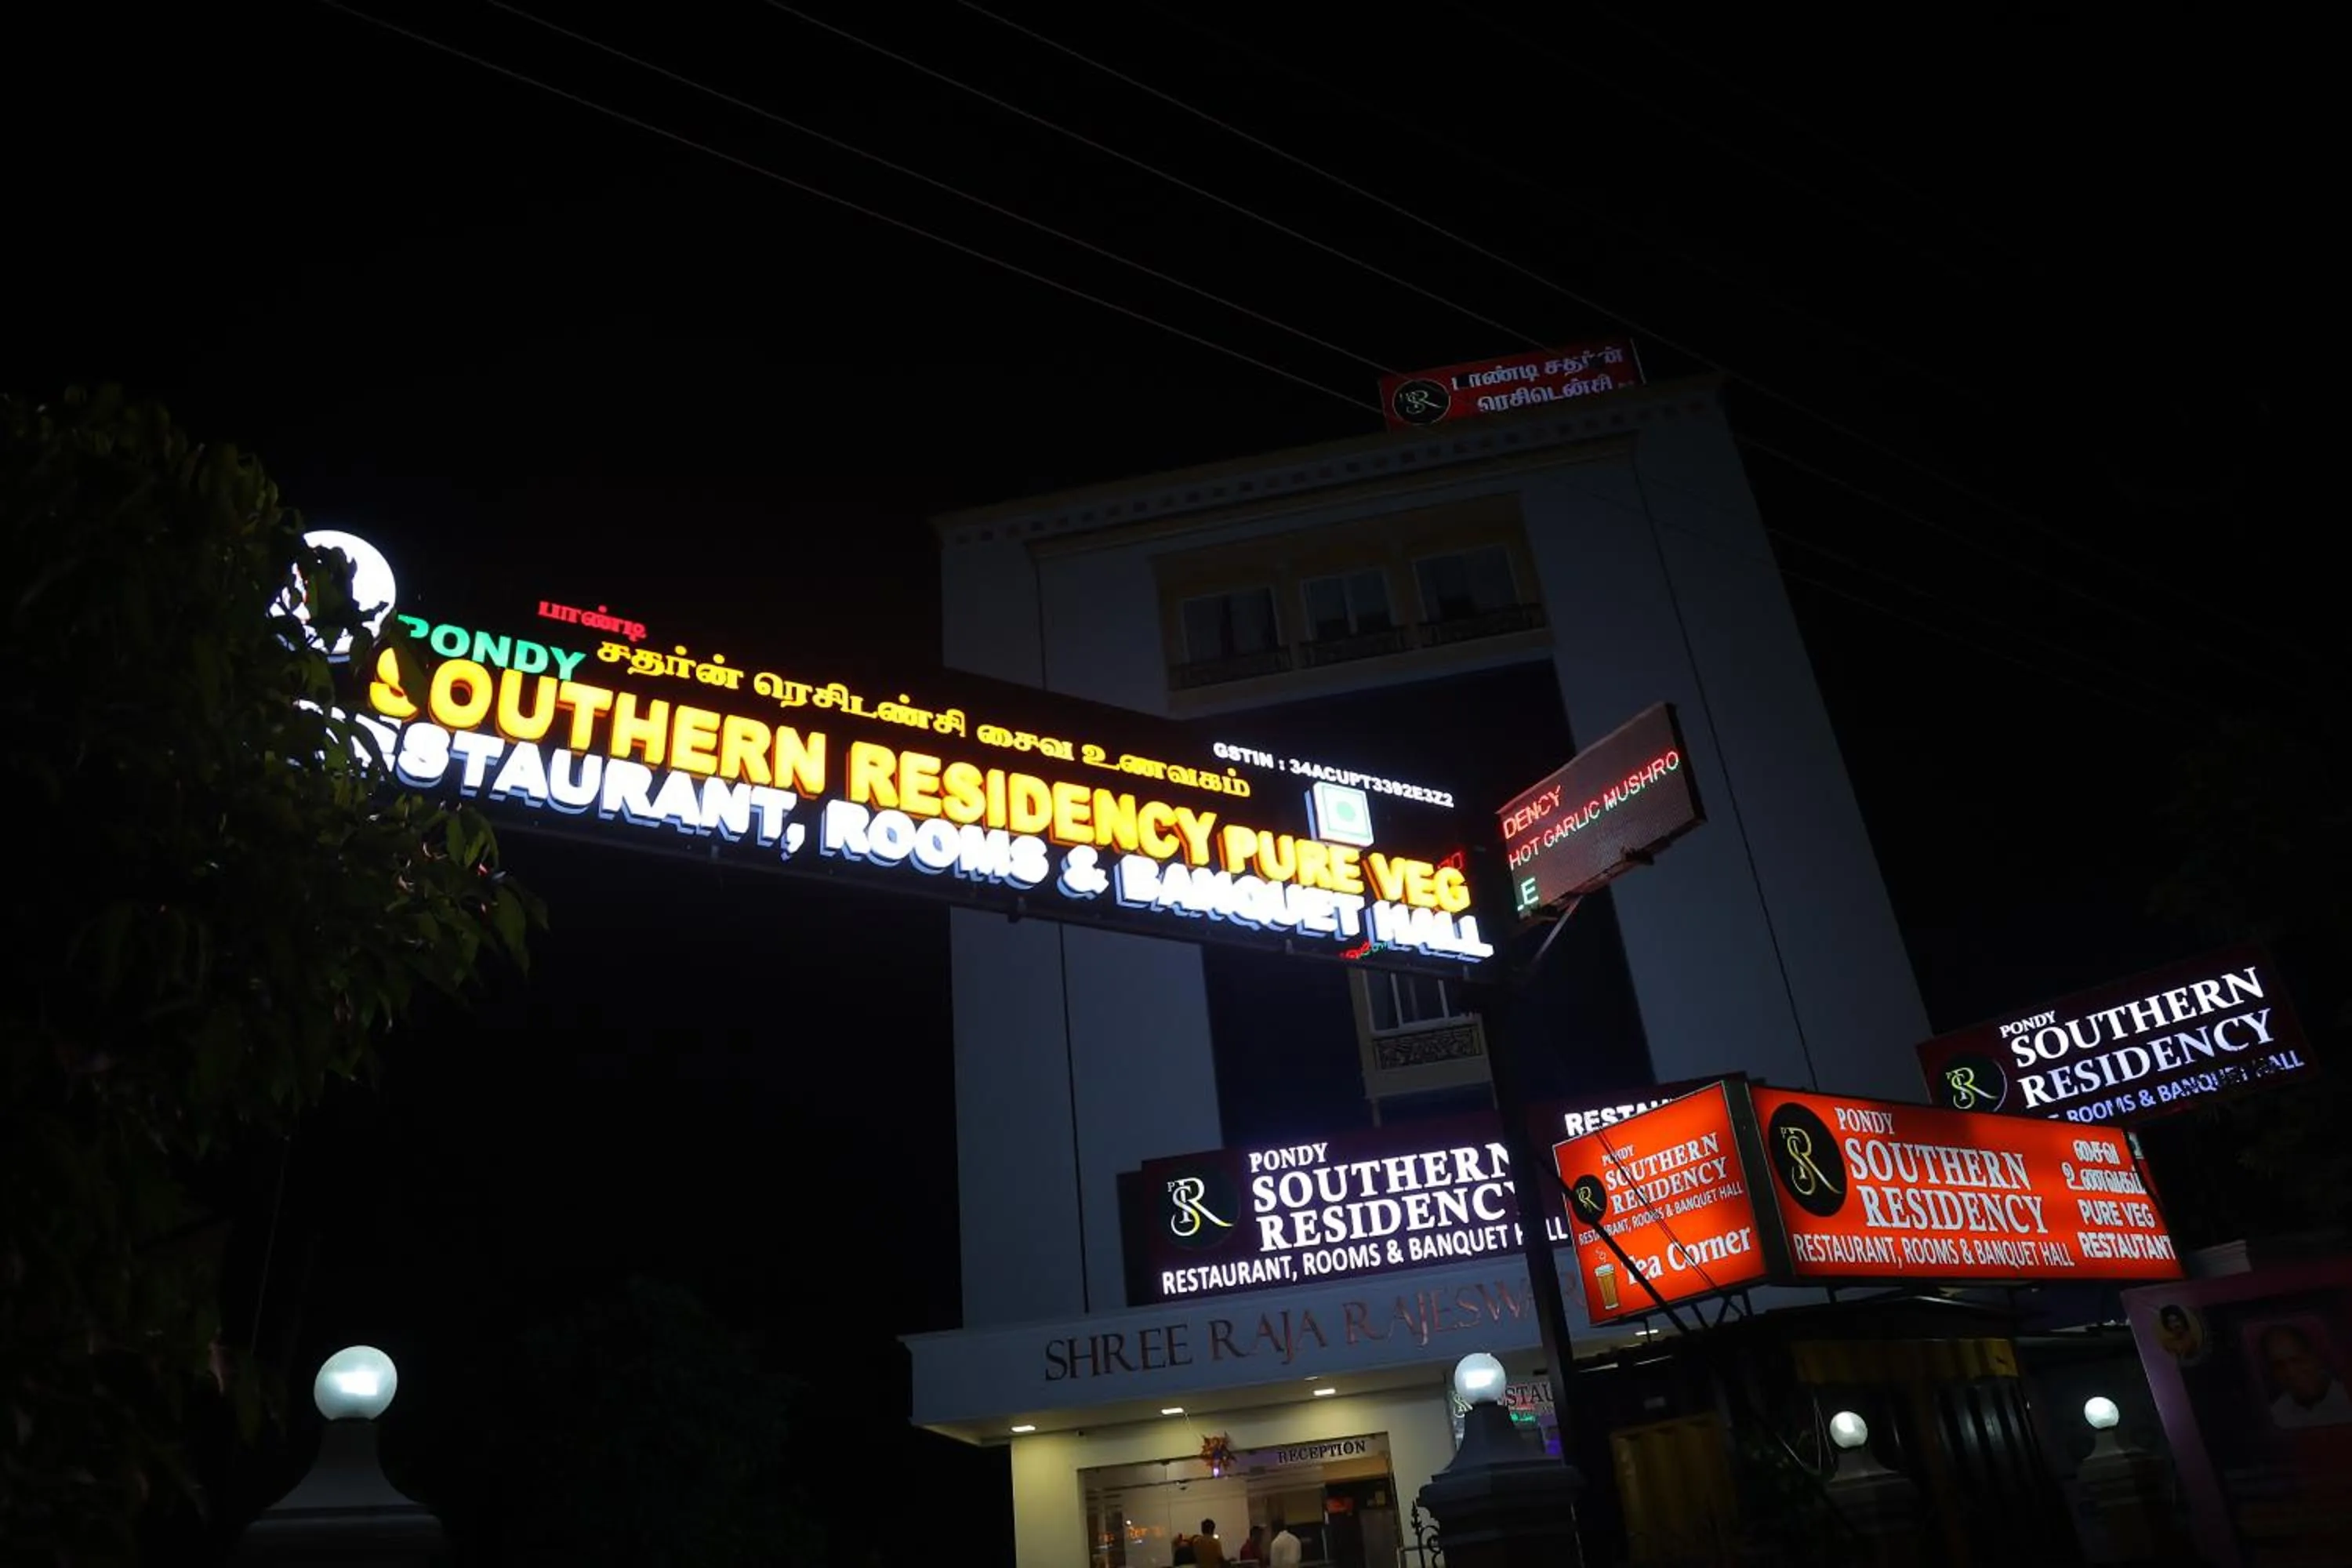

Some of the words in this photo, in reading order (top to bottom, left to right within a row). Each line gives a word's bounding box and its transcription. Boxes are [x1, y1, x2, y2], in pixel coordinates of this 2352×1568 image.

[538, 601, 647, 641] பாண்டி
[597, 641, 744, 690] சதர்ன்
[977, 724, 1074, 762] சைவ
[1082, 744, 1250, 798] உணவகம்
[1213, 742, 1275, 769] GSTIN
[295, 699, 806, 861] STAURANT,
[820, 799, 1049, 890] ROOMS
[1057, 844, 1109, 900] &
[1115, 855, 1365, 941] BANQUET
[1365, 900, 1494, 963] HALL
[847, 741, 1217, 864] RESIDENCY
[1219, 824, 1365, 894] PURE
[1363, 852, 1472, 913] VEG
[1502, 785, 1561, 839] DENCY
[1508, 836, 1540, 870] HOT
[1543, 800, 1601, 848] GARLIC
[1603, 750, 1679, 811] MUSHRO
[1998, 1010, 2057, 1039] PONDY
[2010, 966, 2265, 1068] SOUTHERN
[2016, 1008, 2274, 1109] RESIDENCY
[2138, 1088, 2156, 1108] &
[2252, 1049, 2305, 1079] ALL
[1834, 1106, 1895, 1135] PONDY
[1249, 1142, 1328, 1174] PONDY
[1605, 1132, 1720, 1192] SOUTHERN
[1845, 1138, 2032, 1191] SOUTHERN
[1256, 1181, 1515, 1253] RESIDENC
[1675, 1191, 1718, 1213] BANQUET
[1718, 1181, 1744, 1200] HALL
[1857, 1184, 2049, 1235] RESIDENCY
[2078, 1199, 2123, 1227] PURE
[2120, 1202, 2155, 1229] VEG
[1162, 1256, 1298, 1295] RESTAURANT,
[1303, 1240, 1381, 1276] ROOMS
[1386, 1239, 1404, 1264] &
[1410, 1225, 1508, 1260] BANQUET
[1515, 1217, 1568, 1246] HLL
[1667, 1226, 1750, 1272] Corner
[1793, 1232, 1903, 1269] RESTAURANT,
[1903, 1238, 1959, 1265] ROOMS
[1962, 1242, 1974, 1265] &
[1975, 1241, 2039, 1269] BANQUET
[2042, 1241, 2075, 1267] HALL
[1044, 1323, 1193, 1382] SHREE
[1208, 1308, 1327, 1366] RAJA
[1277, 1439, 1367, 1464] RECEPTION
